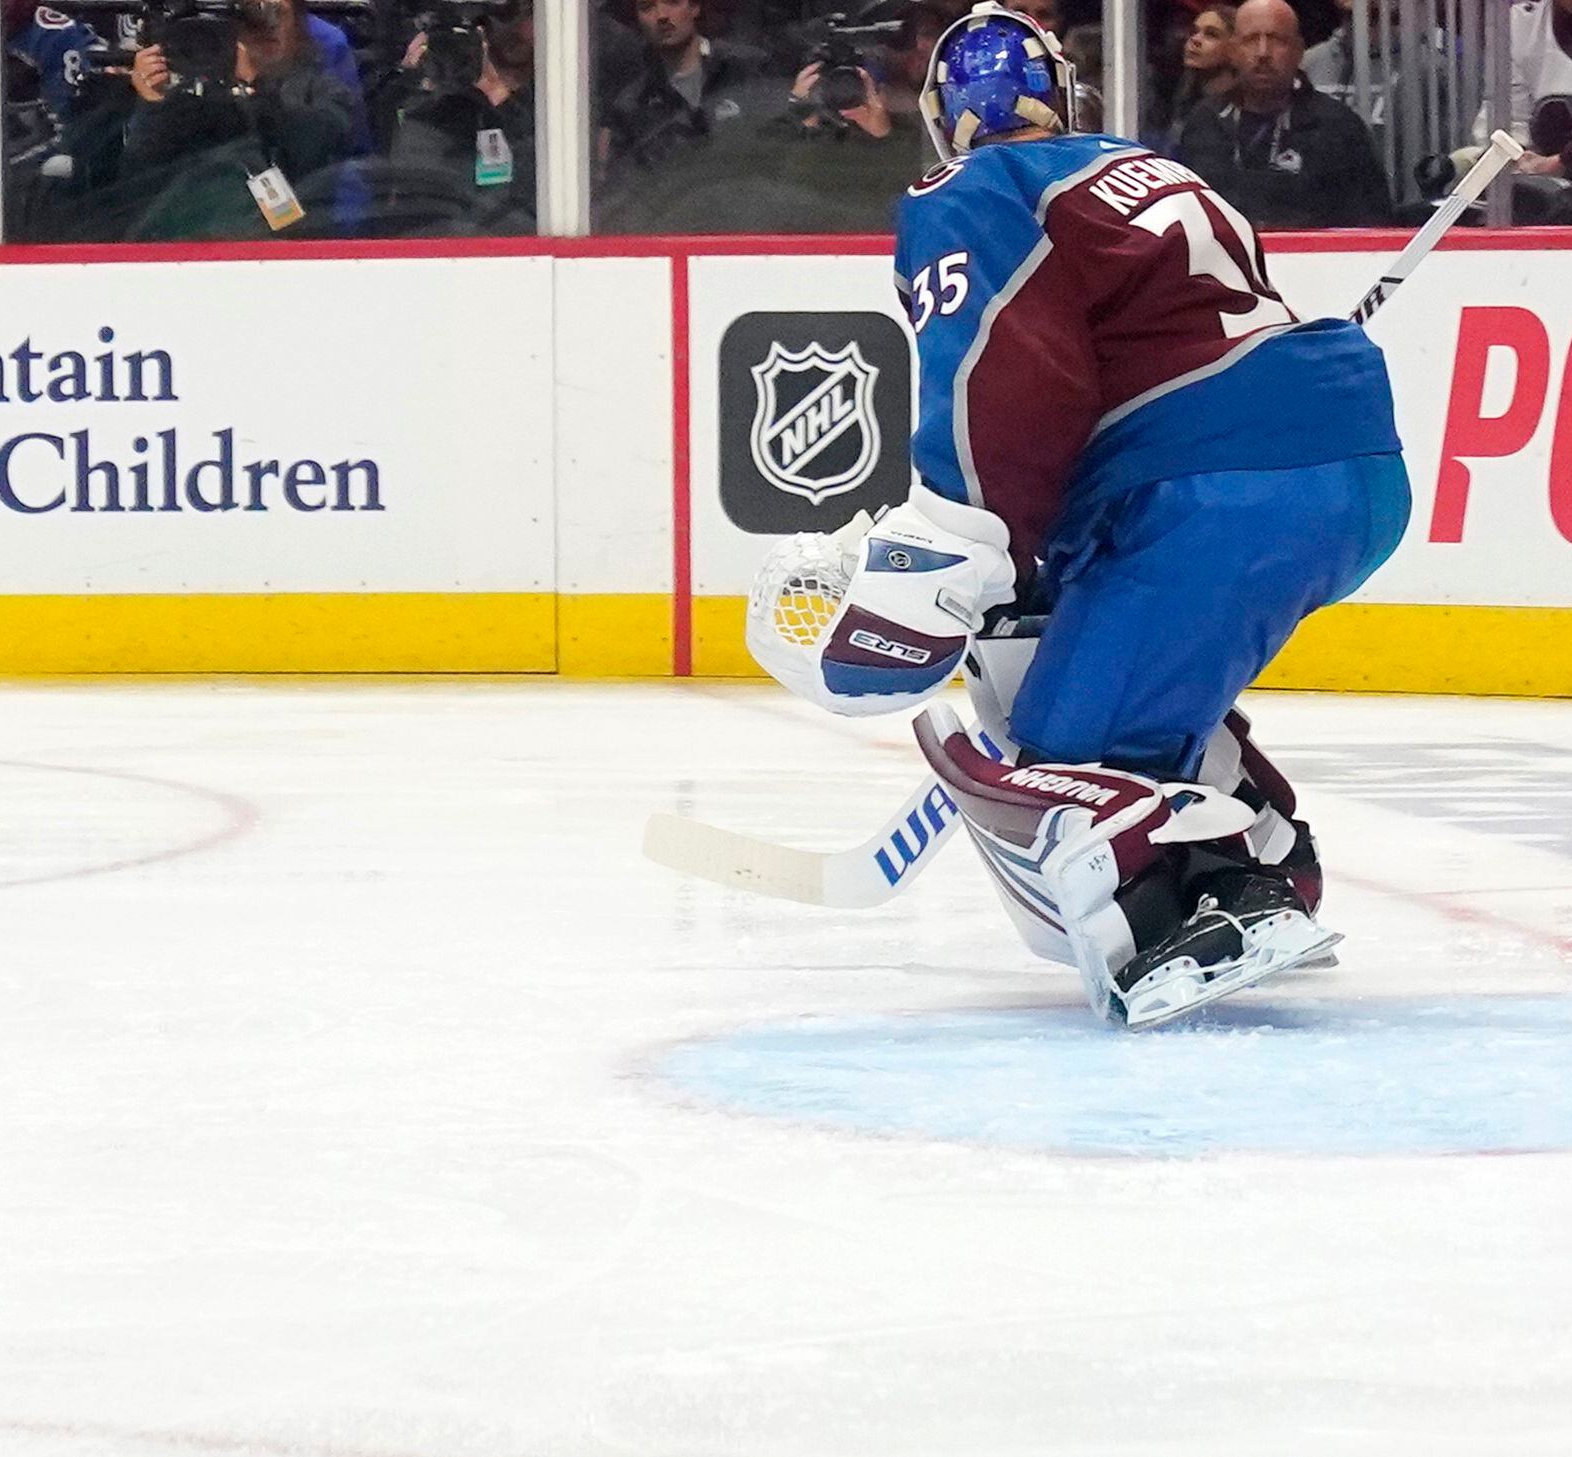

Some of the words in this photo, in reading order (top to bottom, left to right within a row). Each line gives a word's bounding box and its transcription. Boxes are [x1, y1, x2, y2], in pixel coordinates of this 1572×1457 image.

[910, 252, 970, 334] 35
[779, 384, 856, 468] NHL
[1000, 767, 1120, 806] VAUGHN
